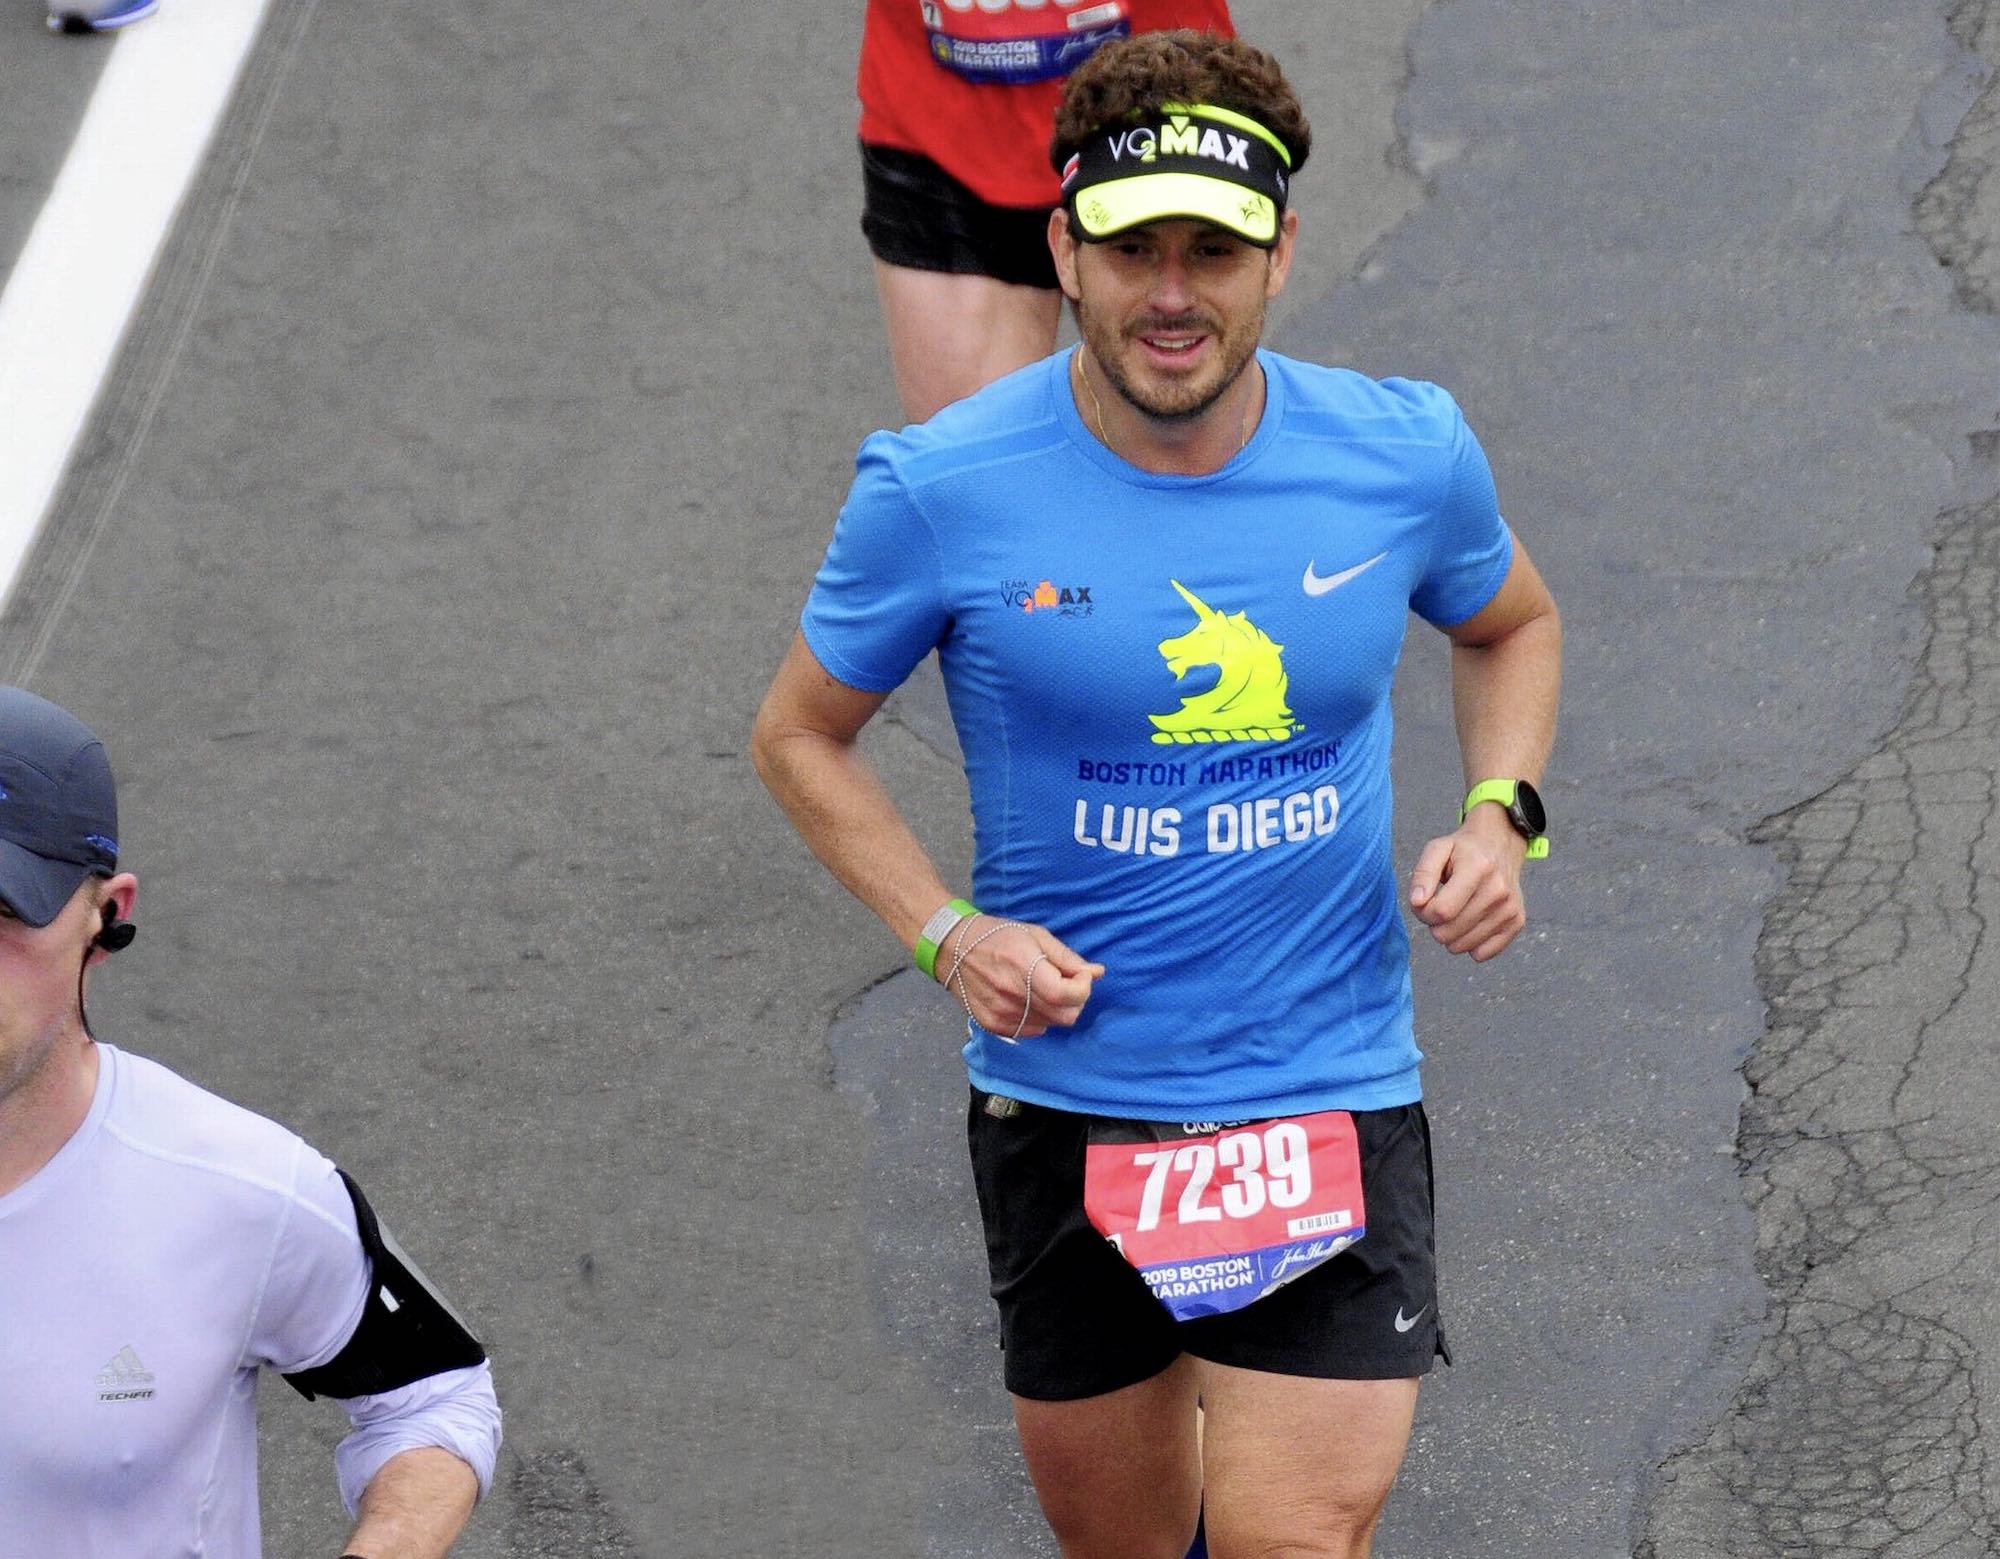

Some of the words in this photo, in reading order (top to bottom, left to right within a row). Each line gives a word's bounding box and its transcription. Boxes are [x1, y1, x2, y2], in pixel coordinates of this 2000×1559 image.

[954, 52, 1039, 68] MARATHON
[978, 40, 1037, 54] BOSTON
[1078, 759, 1185, 786] BOSTON
[1200, 744, 1340, 785] MARATHON
[1074, 799, 1182, 856] LUIS
[1207, 784, 1340, 854] DIEGO
[1133, 1123, 1312, 1232] 7239
[1142, 1268, 1177, 1285] 2019
[1180, 1257, 1250, 1280] BOSTON
[99, 1390, 153, 1401] TECHFIT
